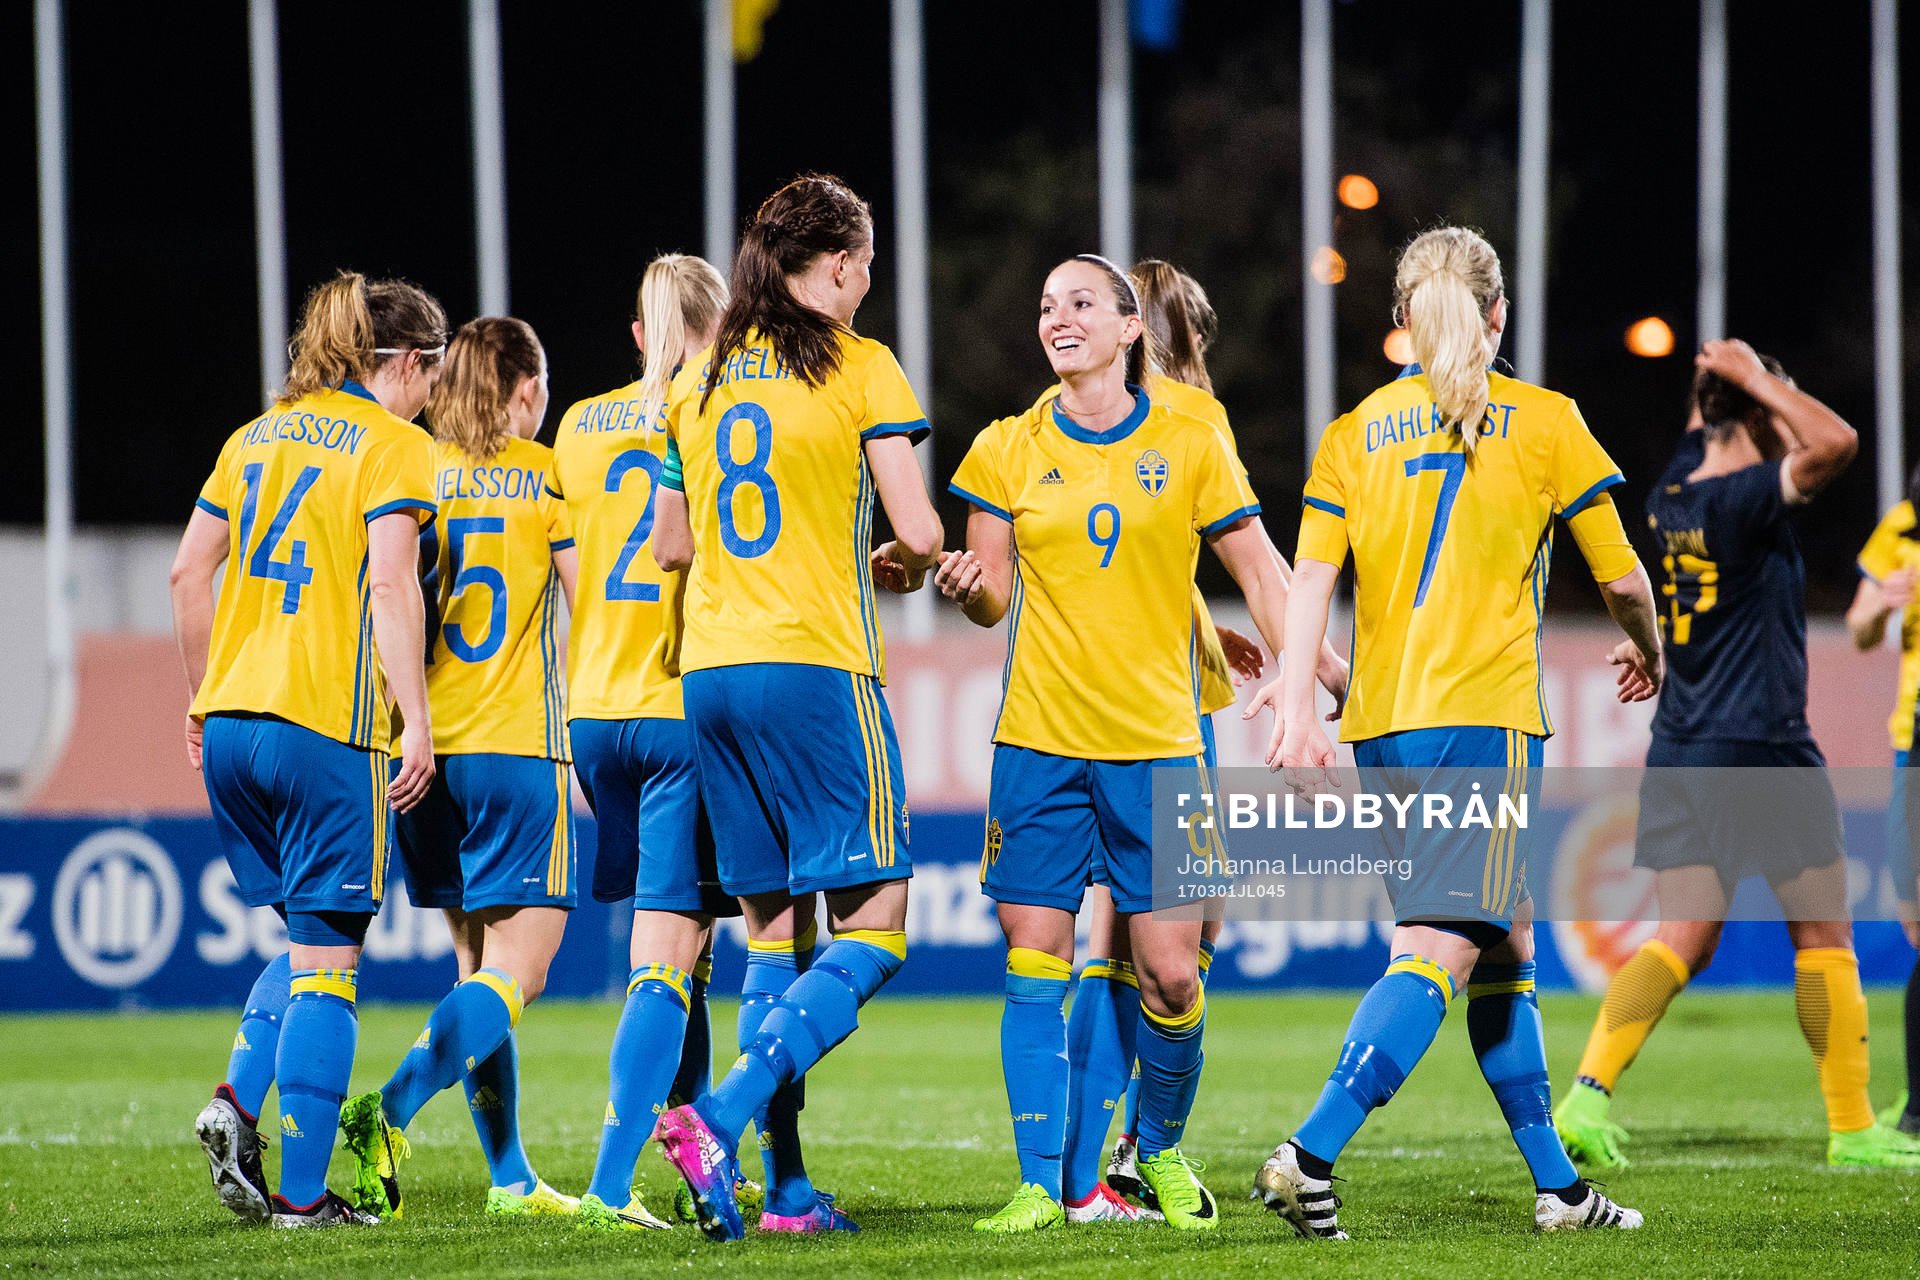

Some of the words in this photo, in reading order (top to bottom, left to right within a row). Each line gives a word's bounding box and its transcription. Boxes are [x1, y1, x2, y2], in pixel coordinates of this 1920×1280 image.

[240, 411, 367, 455] FOLKESSON
[714, 401, 782, 560] 8
[1366, 401, 1517, 453] DAHLKST
[239, 462, 322, 614] 14
[604, 448, 664, 602] 2
[1087, 502, 1121, 568] 9
[1404, 452, 1467, 609] 7
